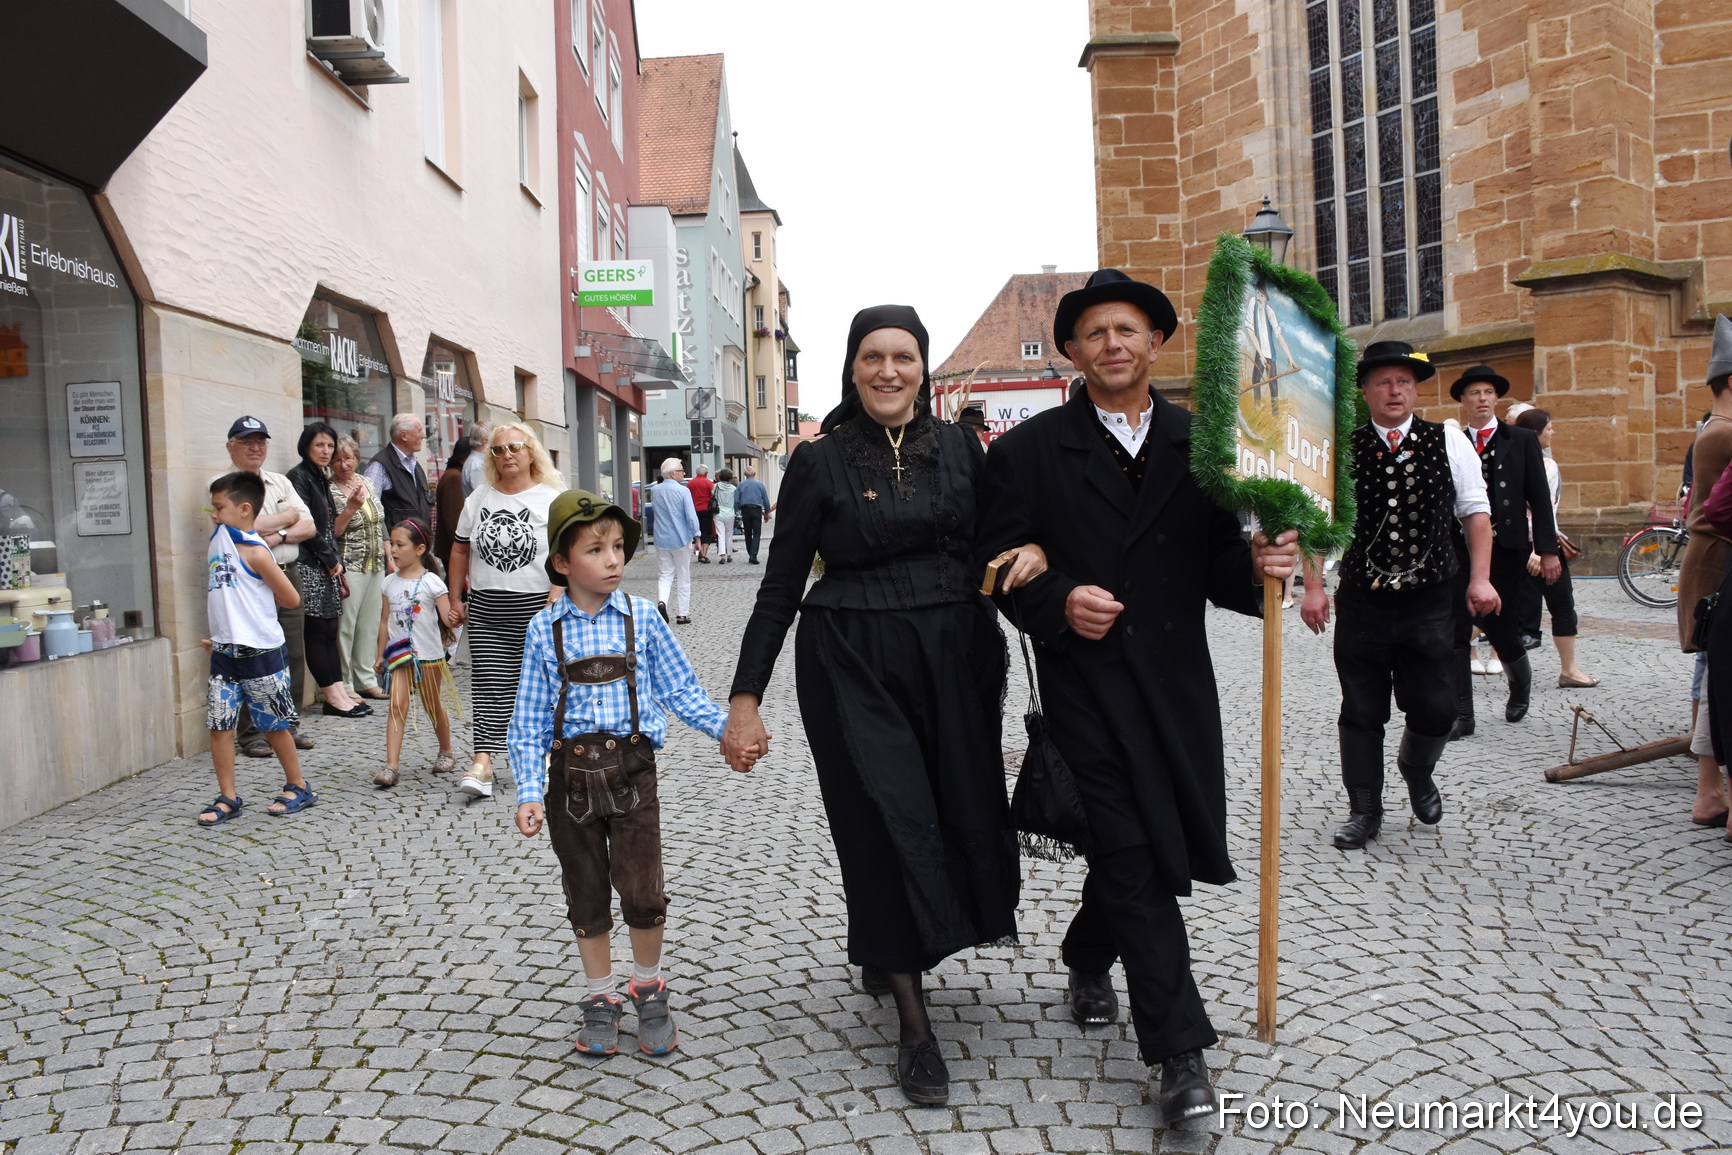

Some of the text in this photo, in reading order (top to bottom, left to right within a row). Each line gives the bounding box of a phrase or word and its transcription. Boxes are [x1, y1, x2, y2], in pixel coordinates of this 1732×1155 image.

[18, 218, 26, 256] RATHAUS
[30, 243, 119, 288] Erlebnishaus.
[584, 268, 636, 282] GEERS
[584, 293, 637, 302] GUTES HÖREN
[330, 333, 359, 377] RACKL
[1286, 412, 1331, 479] Dorf
